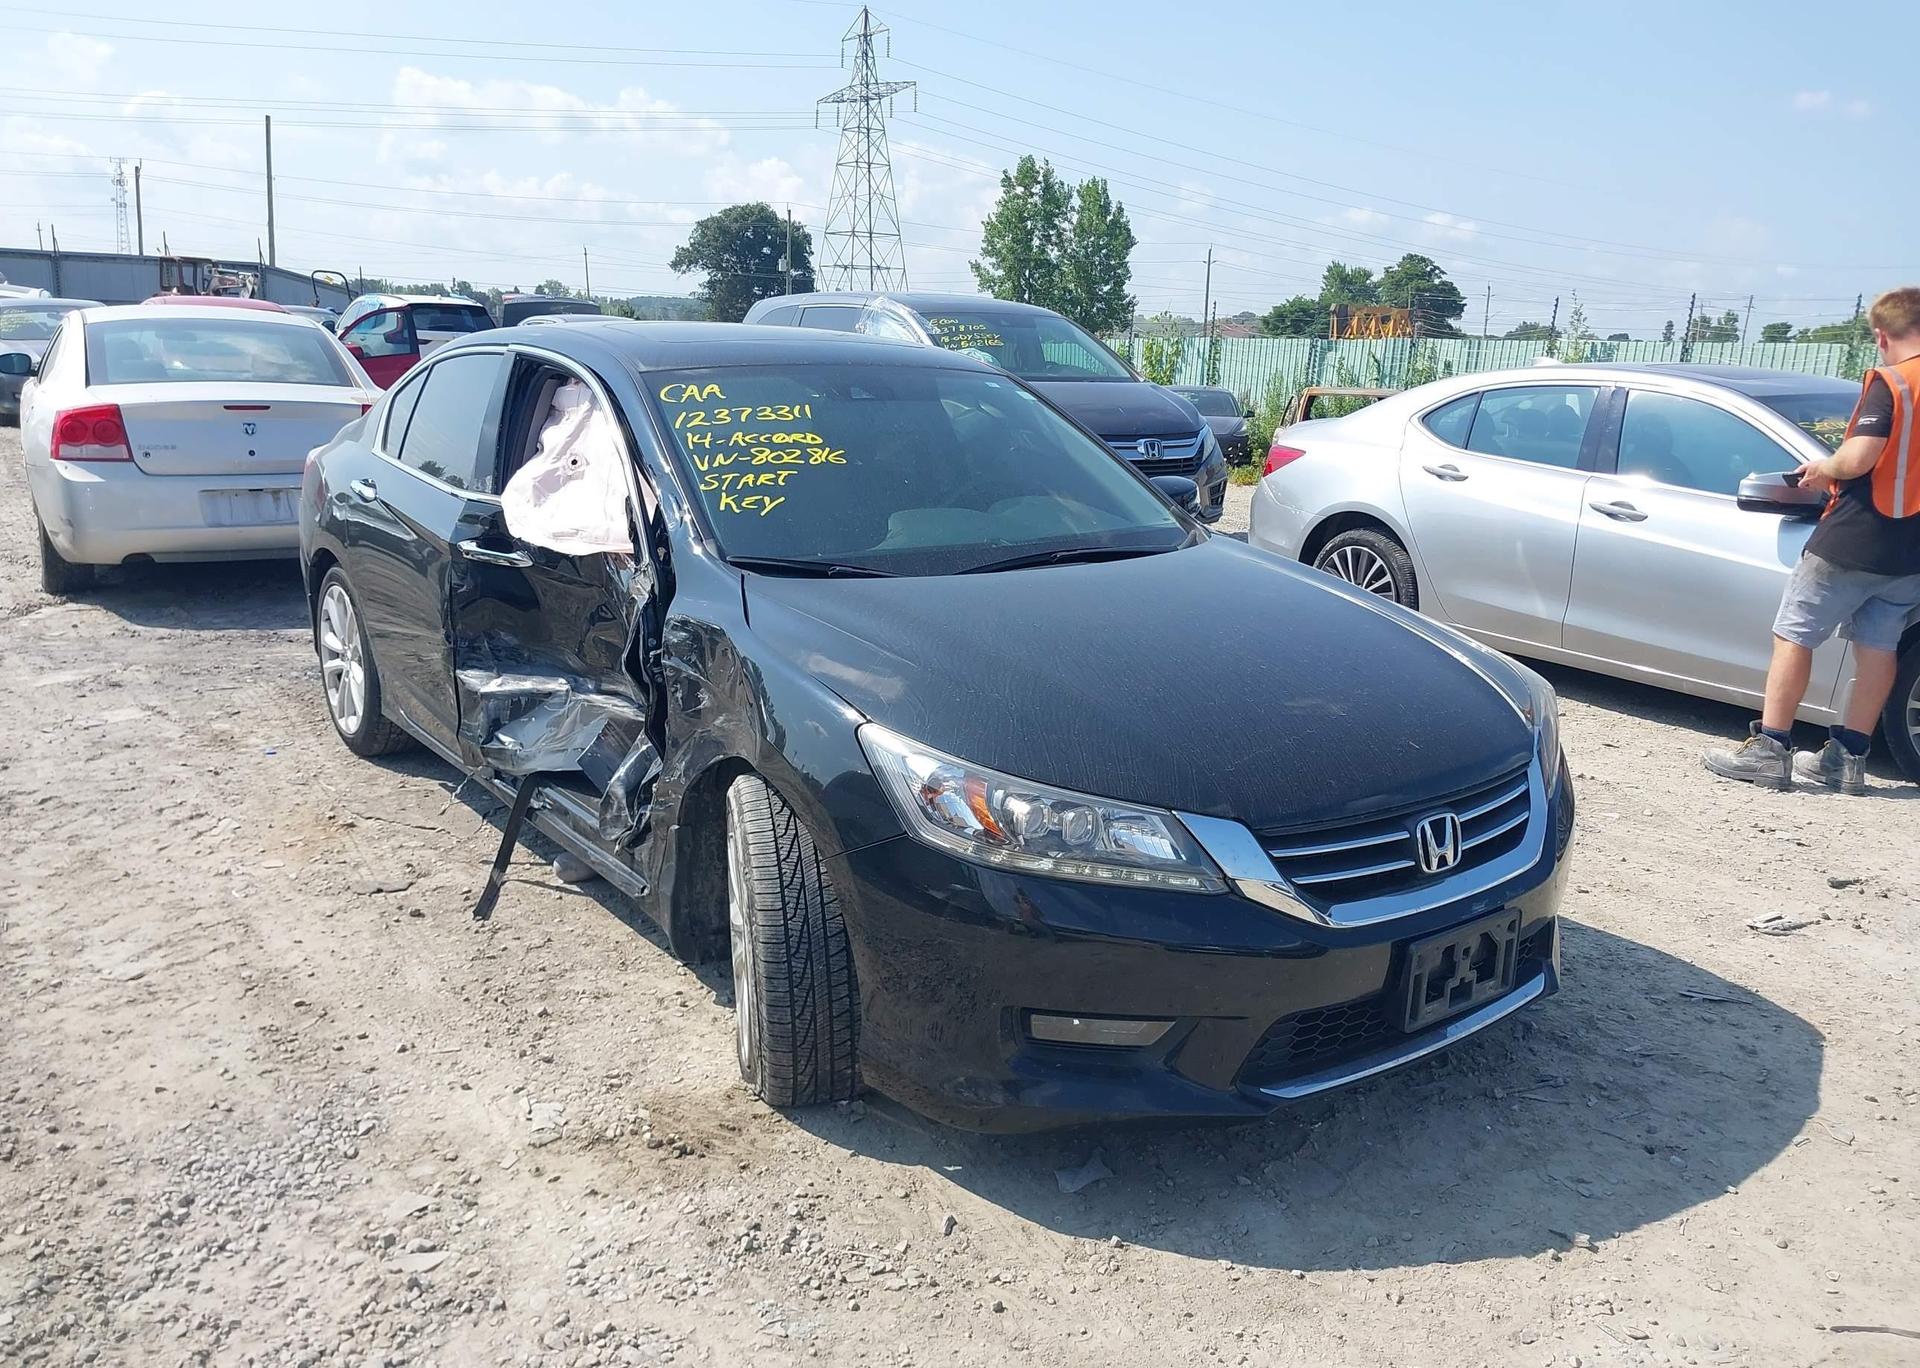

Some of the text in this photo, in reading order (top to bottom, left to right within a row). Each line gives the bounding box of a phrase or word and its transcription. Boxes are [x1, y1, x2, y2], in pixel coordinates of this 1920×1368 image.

[660, 383, 727, 403] CAA
[674, 404, 812, 429] 12373311
[687, 432, 824, 450] 14-ACCORD
[700, 470, 798, 491] START
[719, 492, 785, 516] KEY
